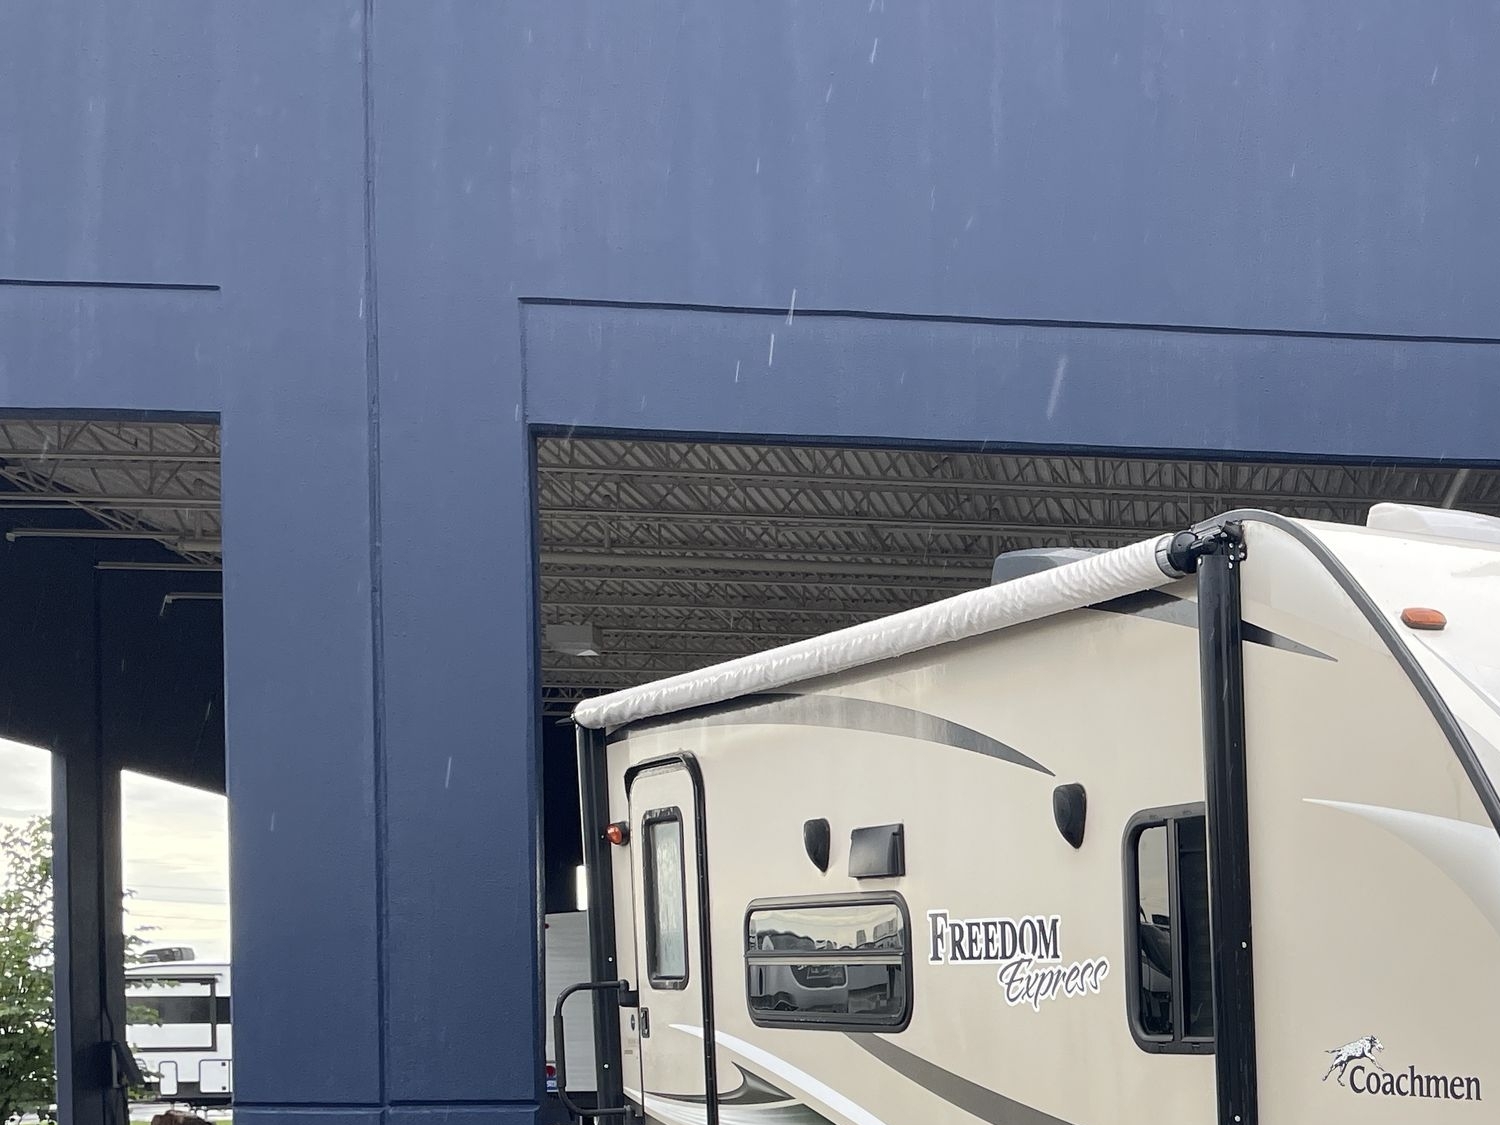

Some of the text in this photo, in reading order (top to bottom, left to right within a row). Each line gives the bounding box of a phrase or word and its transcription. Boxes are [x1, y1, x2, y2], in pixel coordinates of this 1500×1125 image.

[928, 912, 1061, 962] FREEDOM
[998, 957, 1109, 1010] Express
[1350, 1065, 1482, 1101] Coachmen
